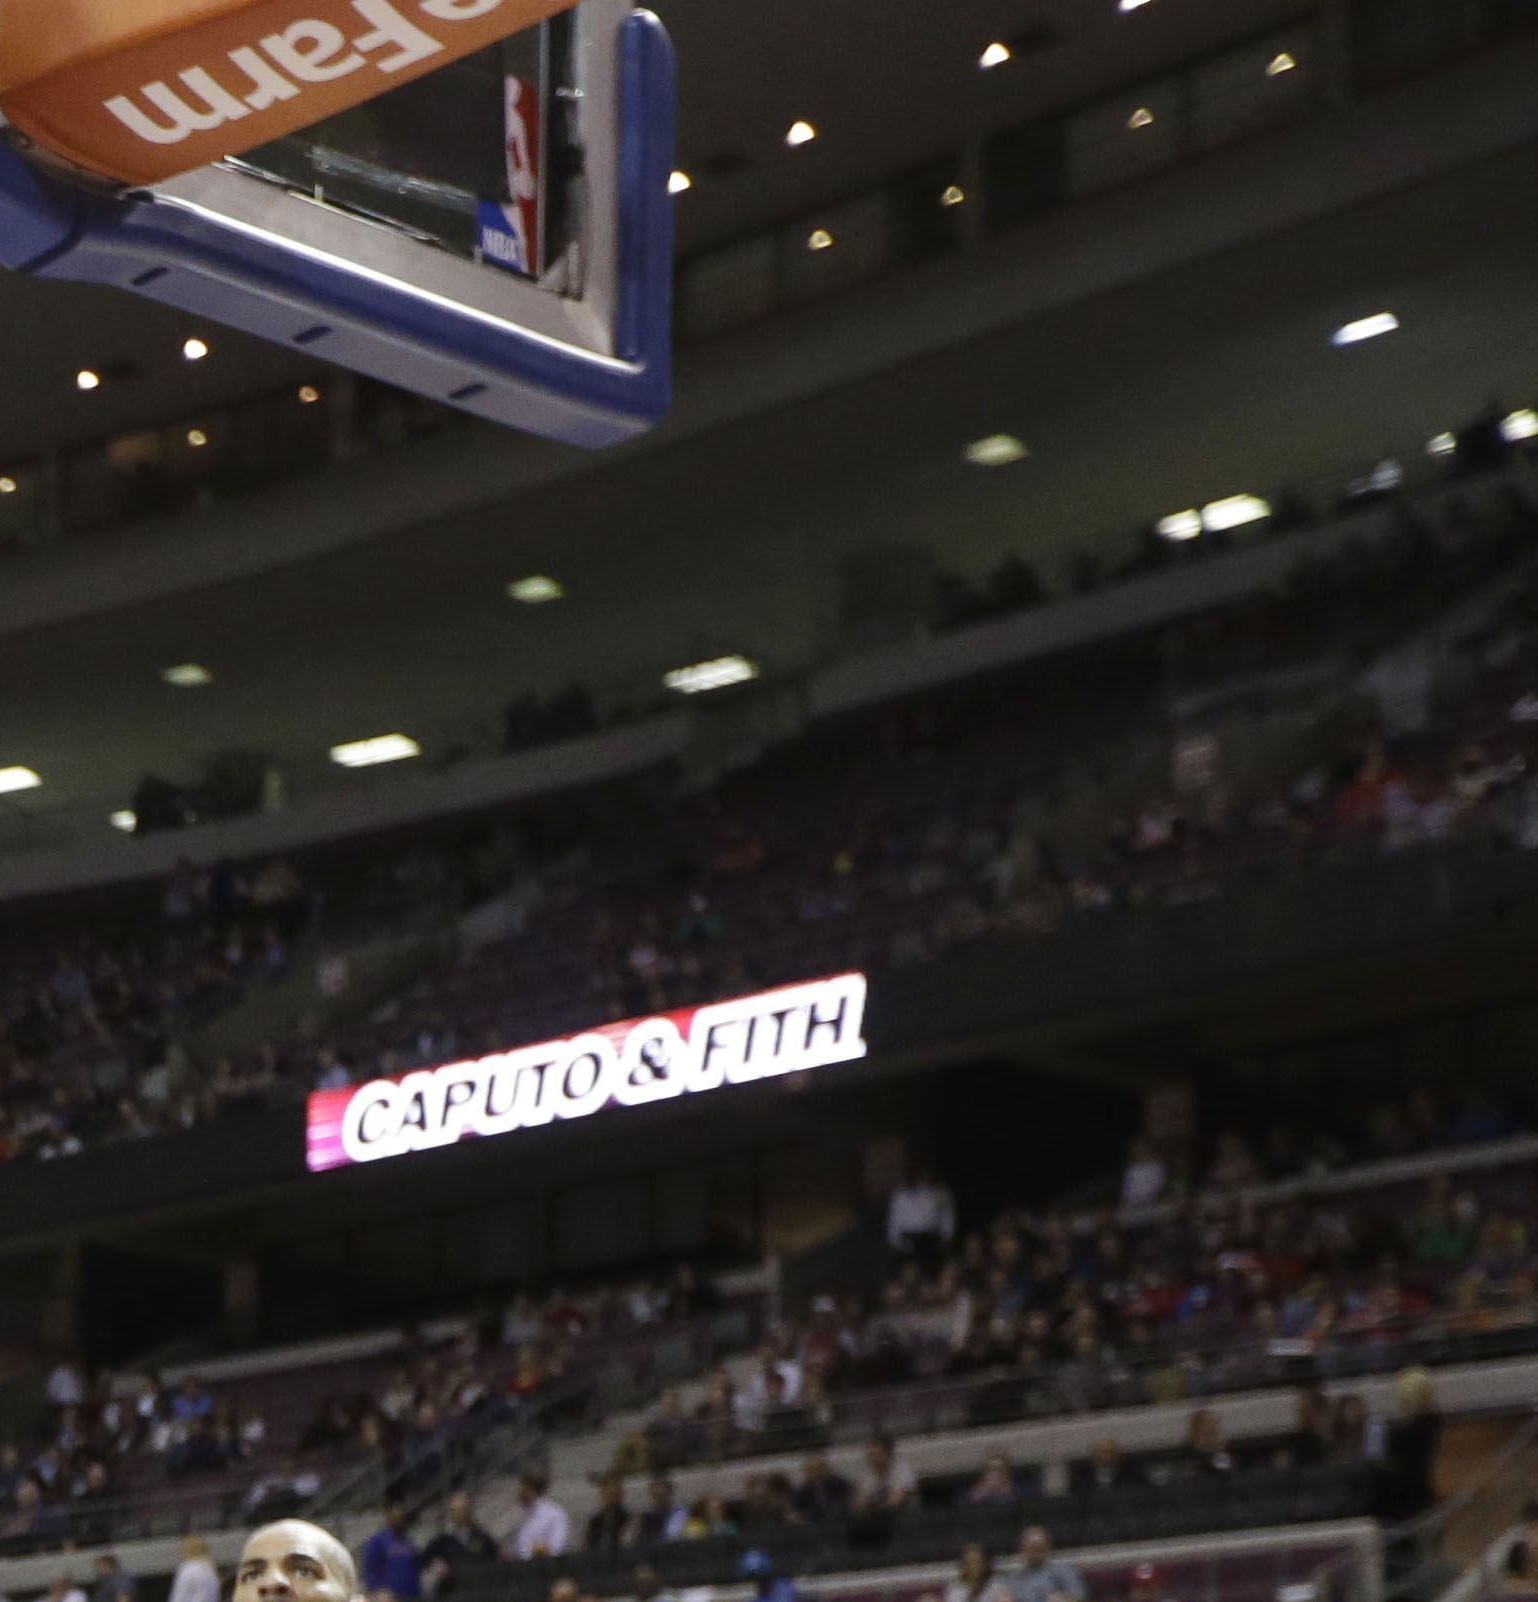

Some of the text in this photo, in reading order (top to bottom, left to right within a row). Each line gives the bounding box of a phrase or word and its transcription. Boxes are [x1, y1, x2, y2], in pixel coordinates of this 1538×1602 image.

[104, 0, 444, 145] Farm
[356, 995, 850, 1145] CAPUTO & FITH
